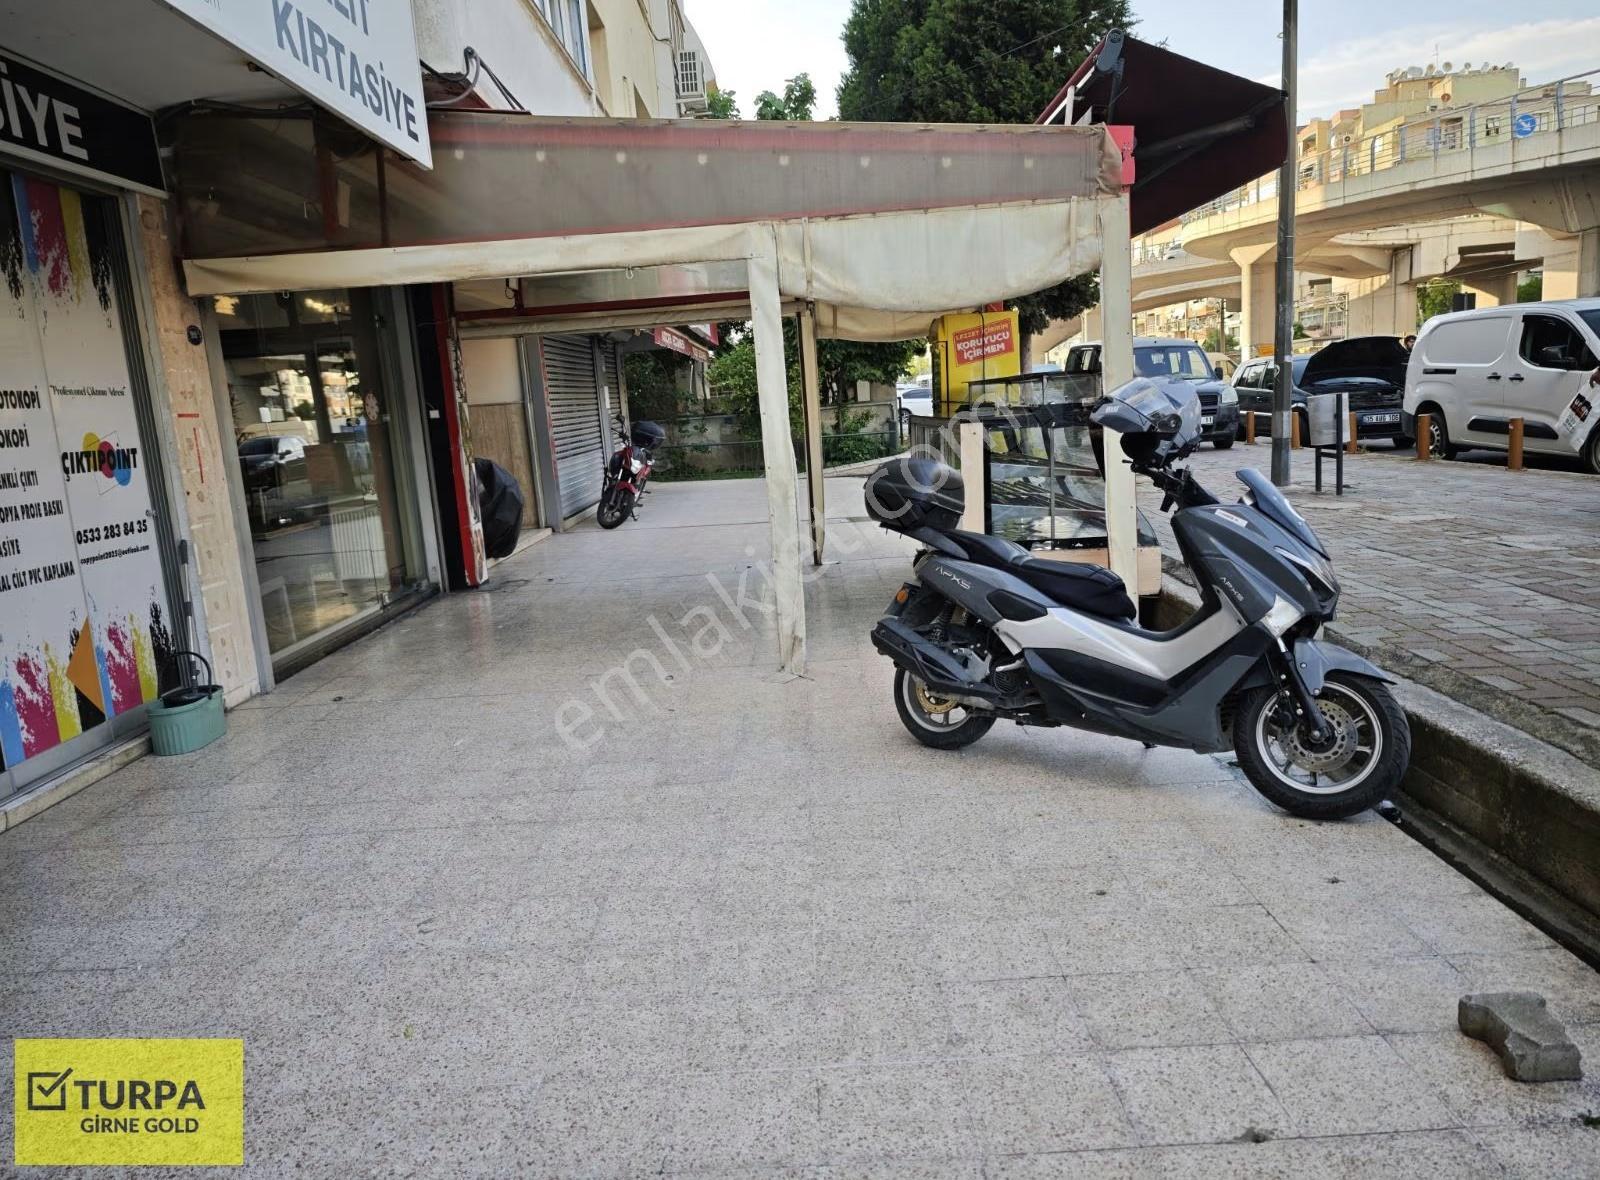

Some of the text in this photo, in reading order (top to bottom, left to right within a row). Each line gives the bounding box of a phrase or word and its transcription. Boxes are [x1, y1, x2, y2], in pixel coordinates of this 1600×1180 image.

[272, 0, 419, 142] KIRTASİYE
[0, 60, 89, 161] İYE
[957, 331, 1010, 351] KORUYUCU
[0, 467, 38, 492] NKLİ ÇIKTI
[21, 502, 42, 520] PROJE
[43, 500, 63, 517] BASKI
[76, 519, 148, 545] 0533 283 84 35
[12, 568, 27, 589] CİLT
[28, 567, 42, 585] PVC
[43, 561, 75, 581] KAPLAMA
